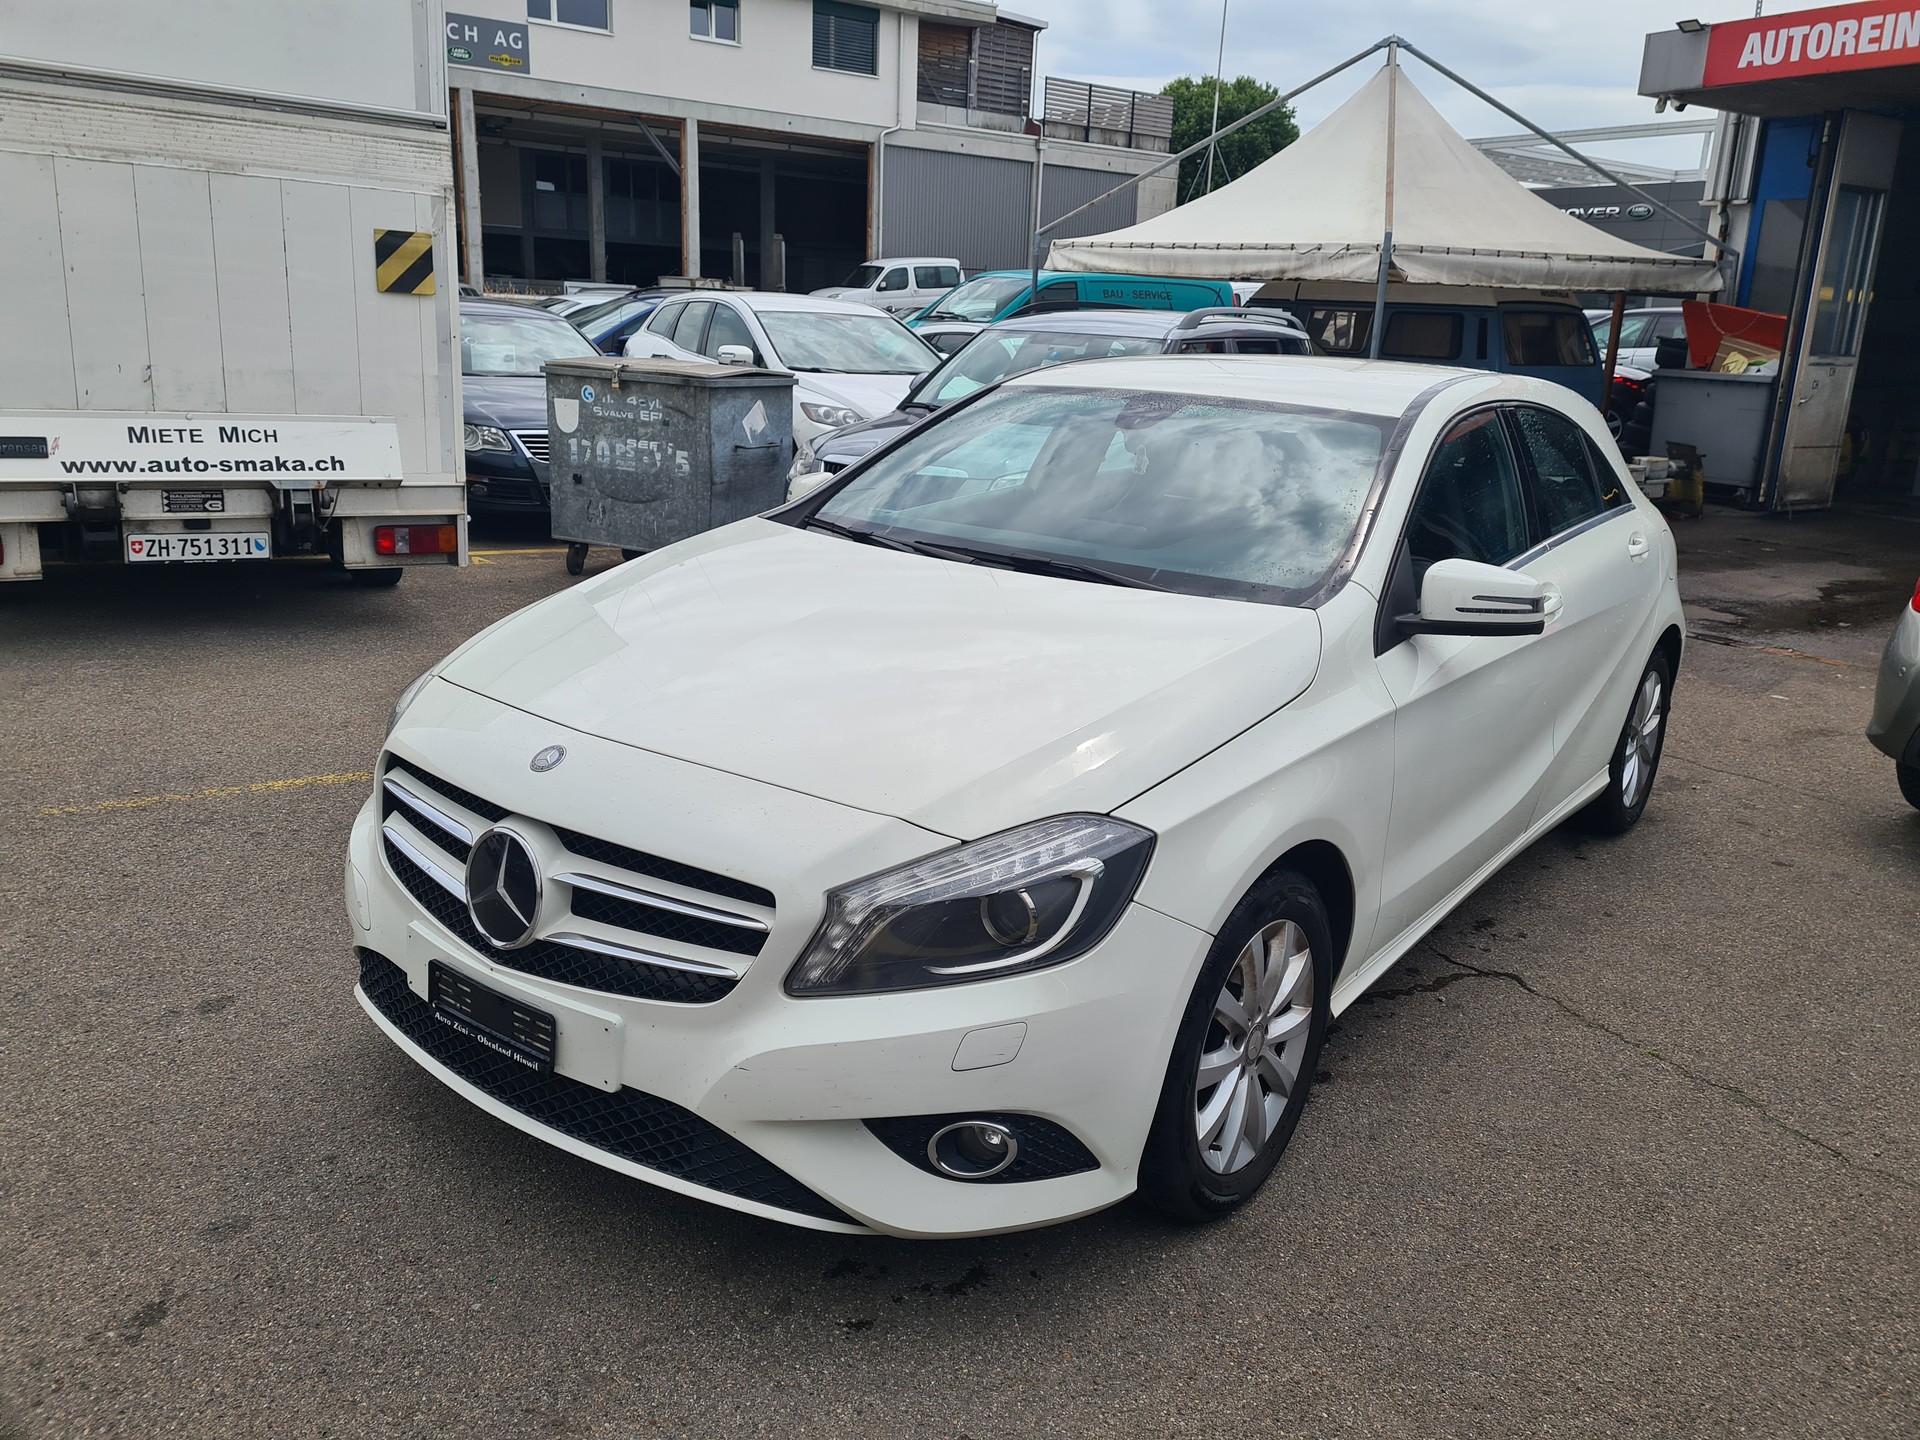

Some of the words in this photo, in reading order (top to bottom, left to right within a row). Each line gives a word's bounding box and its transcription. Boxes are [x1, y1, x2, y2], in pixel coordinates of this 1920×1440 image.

[494, 30, 522, 49] AG
[1737, 9, 1920, 69] AUTOREIN
[1102, 289, 1123, 299] BAU
[1132, 290, 1173, 301] SERVICE
[126, 426, 205, 444] MIETE
[218, 426, 279, 444] MICH
[60, 455, 346, 474] www.auto-smaka.ch
